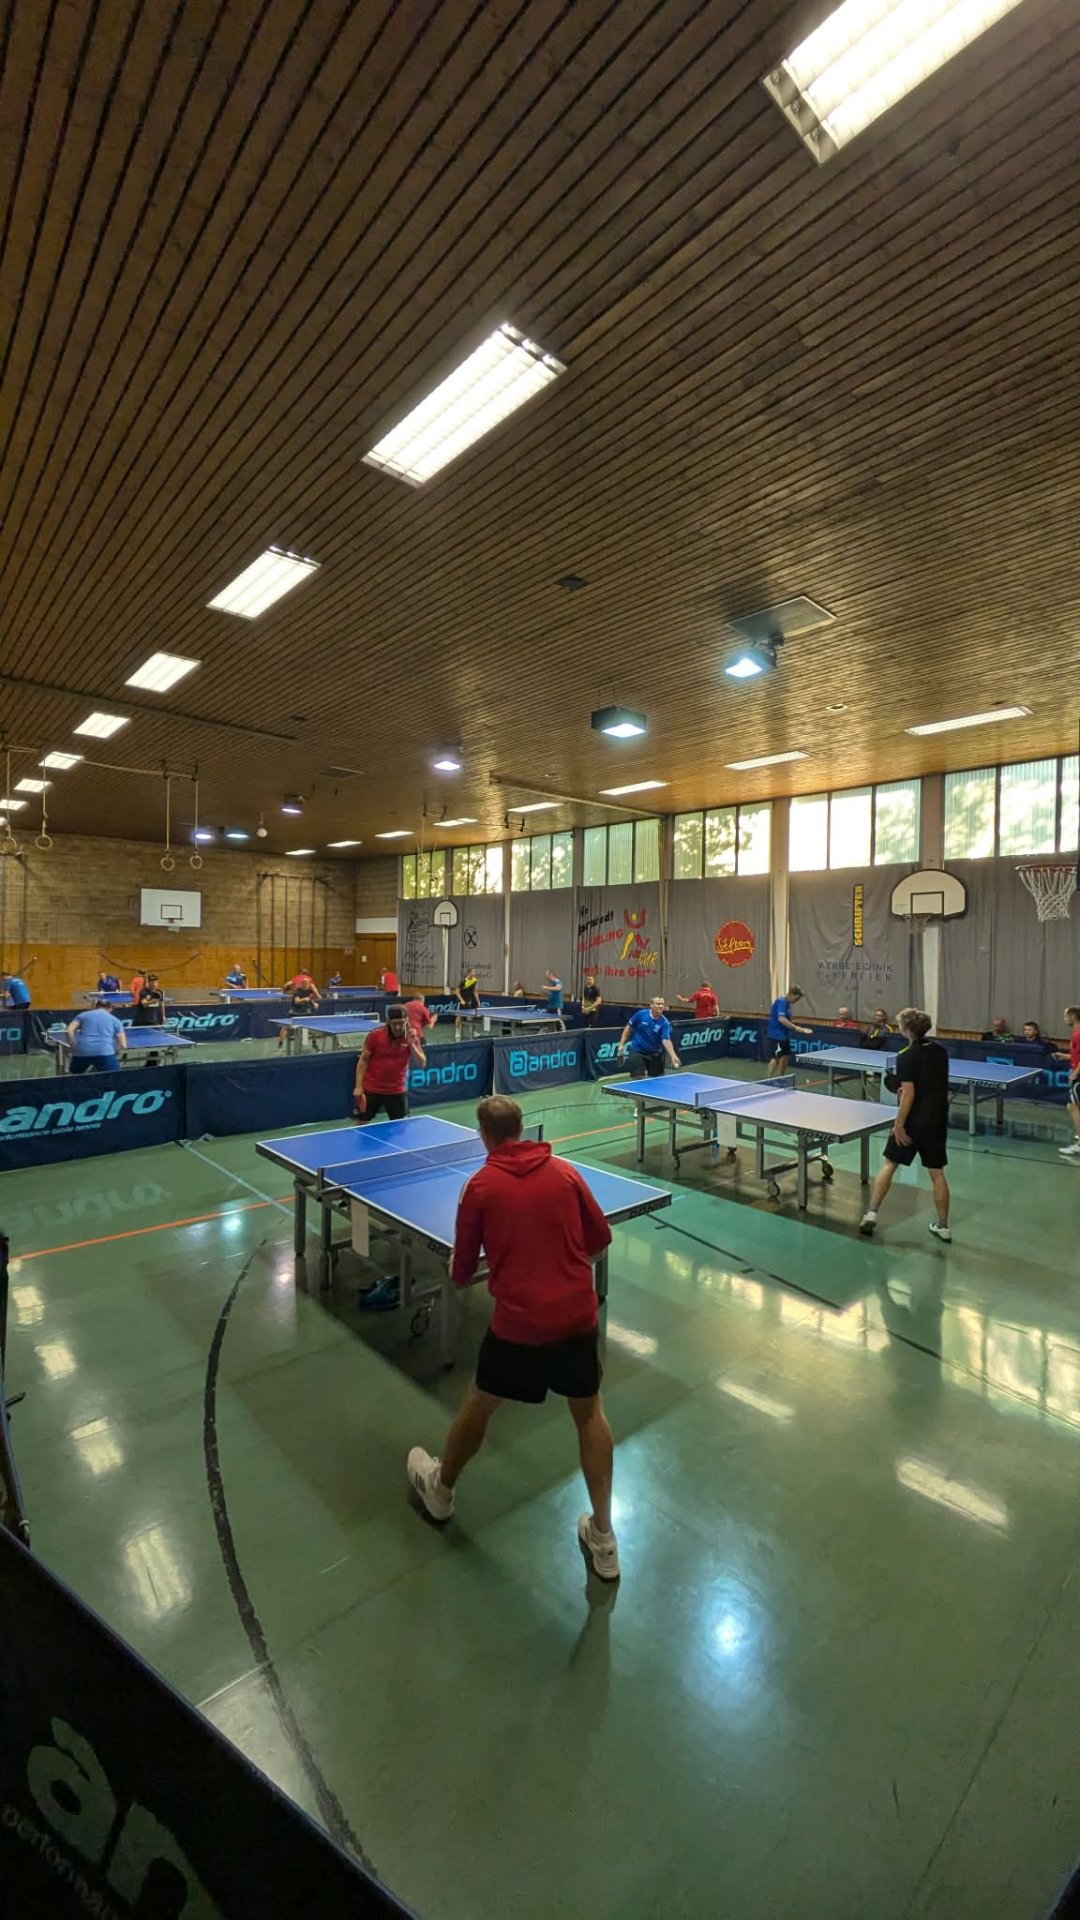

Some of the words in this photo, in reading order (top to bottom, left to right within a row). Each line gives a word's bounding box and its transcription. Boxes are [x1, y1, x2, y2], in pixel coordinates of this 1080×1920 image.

[680, 1027, 724, 1047] andro
[529, 1050, 577, 1072] andro
[411, 1062, 478, 1087] andro
[967, 1079, 1003, 1089] DONIC
[797, 1129, 836, 1143] DONIC
[630, 1198, 668, 1218] DONIC
